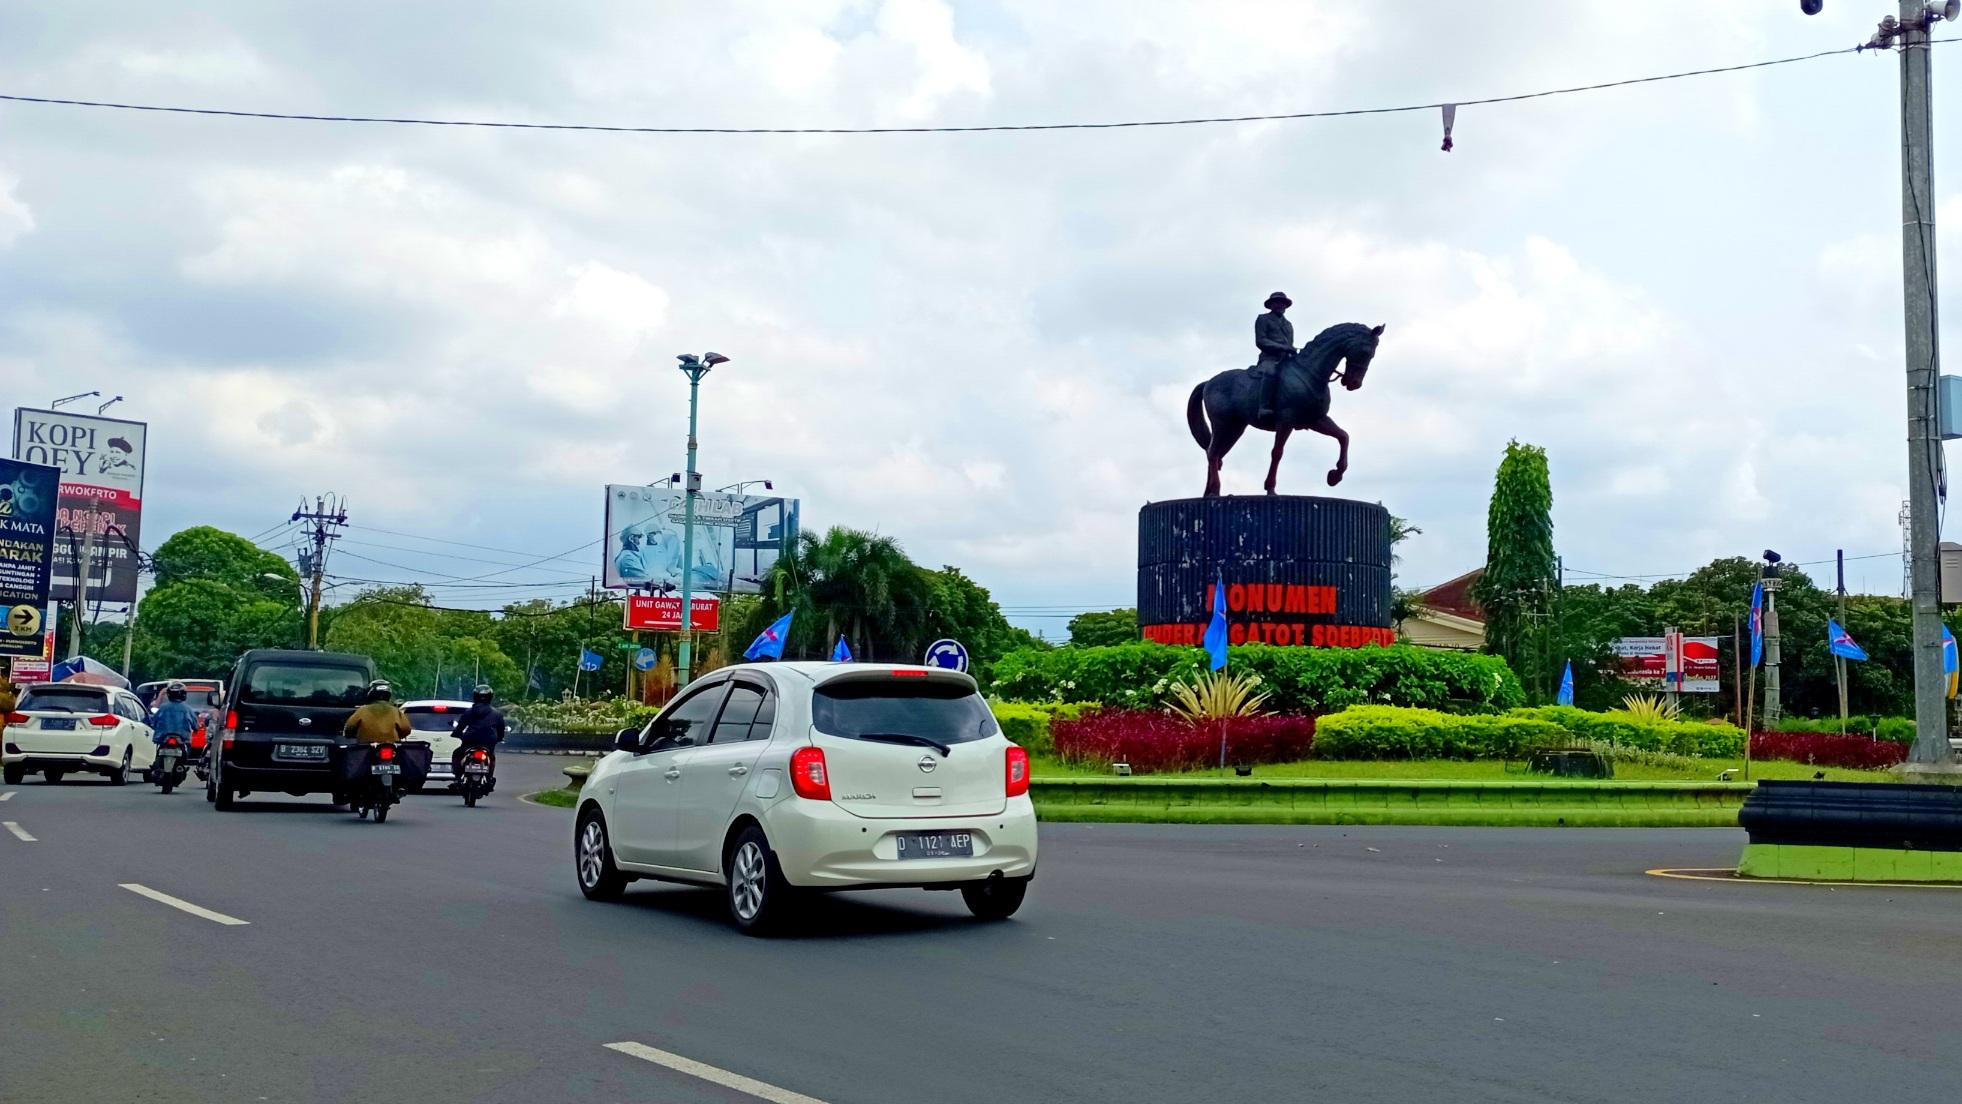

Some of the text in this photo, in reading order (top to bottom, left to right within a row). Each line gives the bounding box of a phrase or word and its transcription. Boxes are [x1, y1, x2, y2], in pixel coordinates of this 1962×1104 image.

[28, 421, 97, 449] KOPI
[26, 445, 96, 475] OEY
[10, 521, 44, 535] MATA
[636, 600, 653, 608] UNIT
[656, 601, 680, 609] GAWAT
[1229, 622, 1304, 646] GATOT
[898, 836, 906, 850] D
[951, 833, 970, 848] AEP
